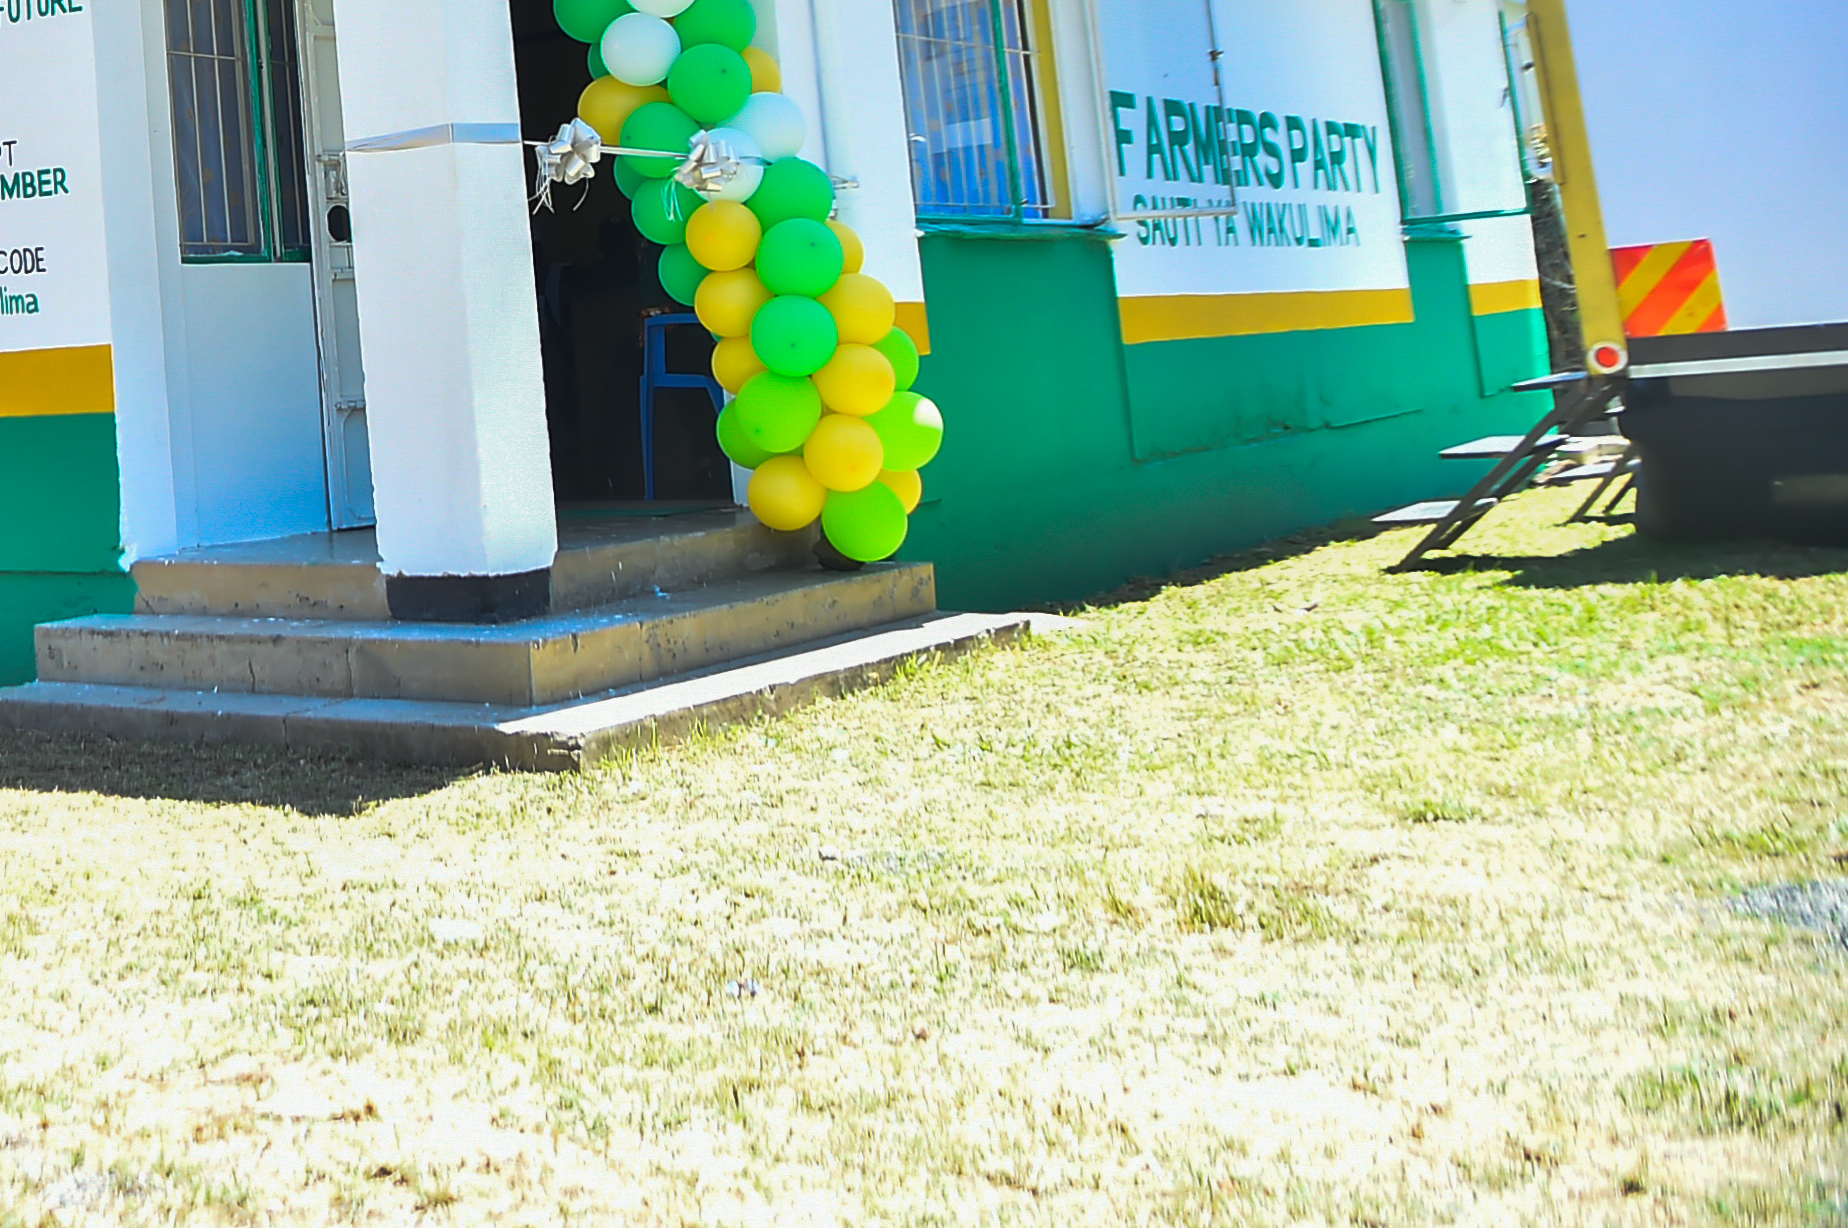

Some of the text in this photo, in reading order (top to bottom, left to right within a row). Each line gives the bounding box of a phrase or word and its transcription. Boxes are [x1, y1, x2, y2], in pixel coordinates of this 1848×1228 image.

[1110, 90, 1380, 193] FARMERS PARTY
[1133, 194, 1360, 247] SAUTI YA WAKULIMA
